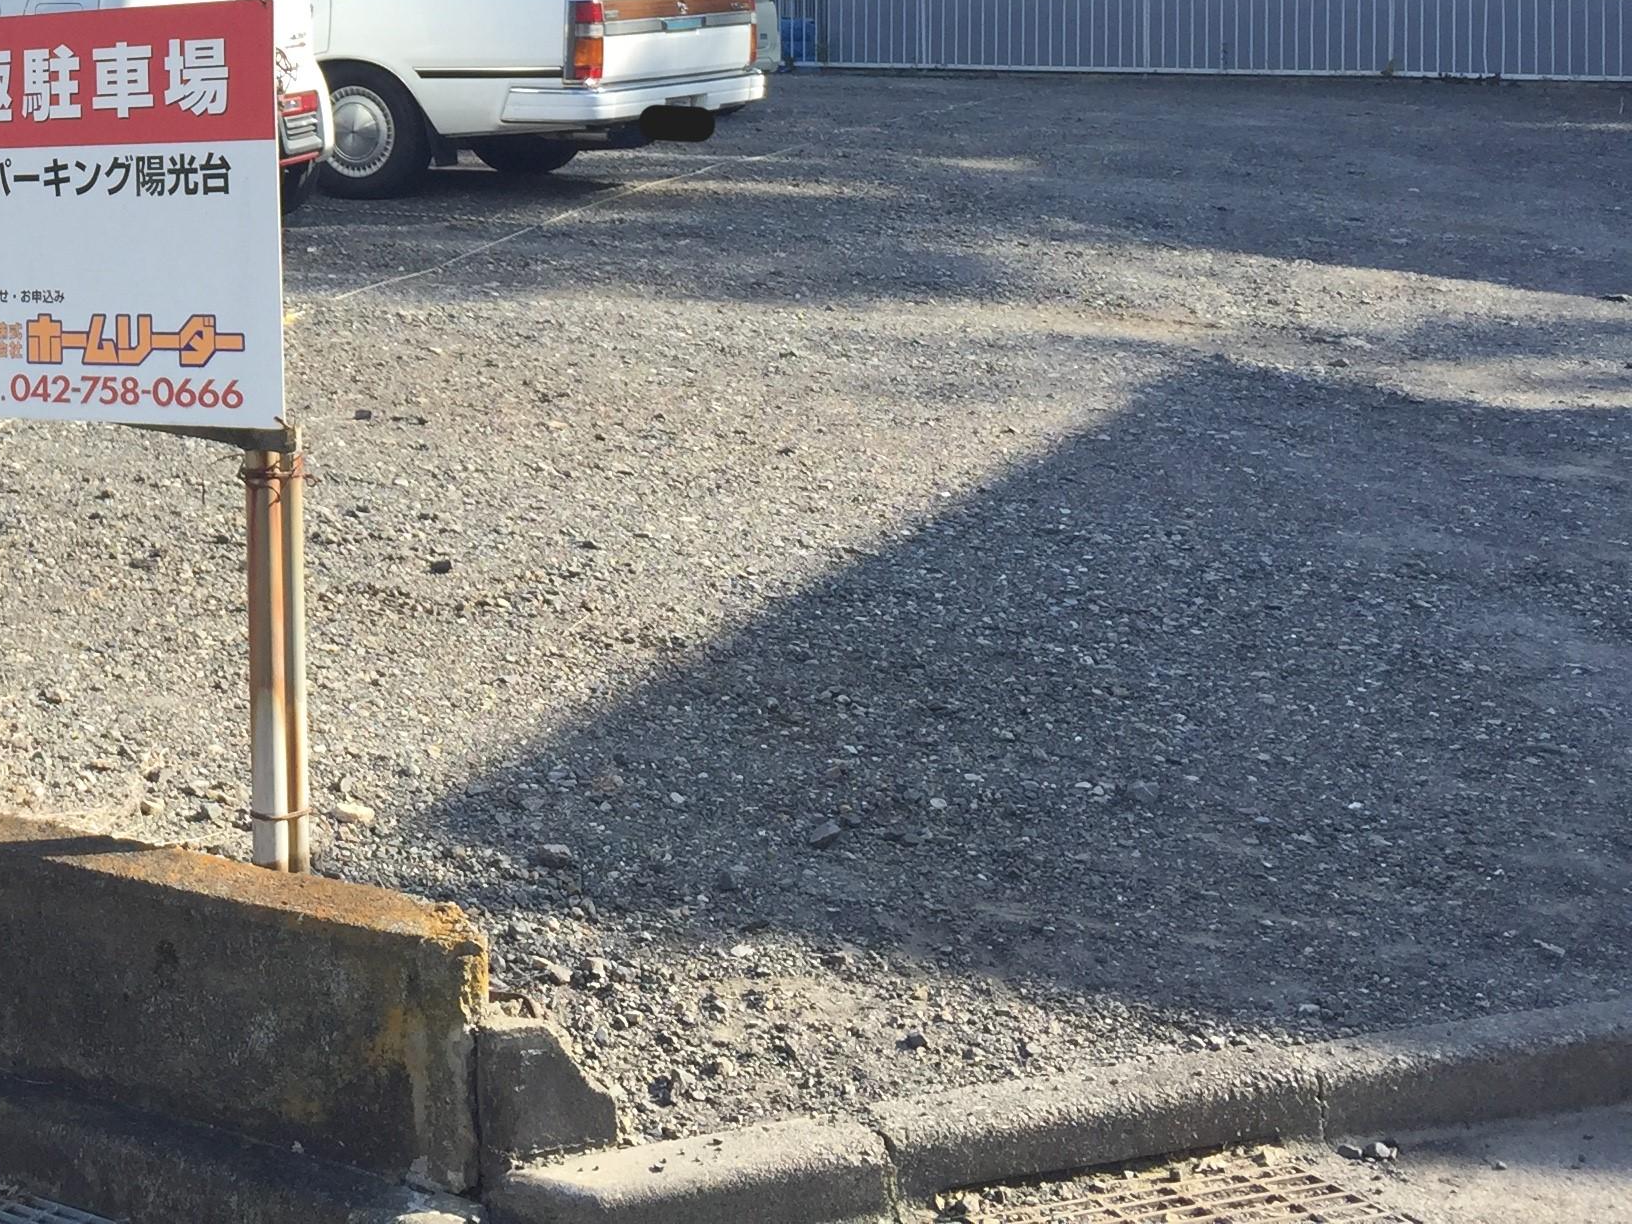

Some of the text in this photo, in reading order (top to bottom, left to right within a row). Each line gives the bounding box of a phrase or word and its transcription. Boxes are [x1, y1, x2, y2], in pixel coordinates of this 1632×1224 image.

[26, 313, 245, 368] ホームリーダー
